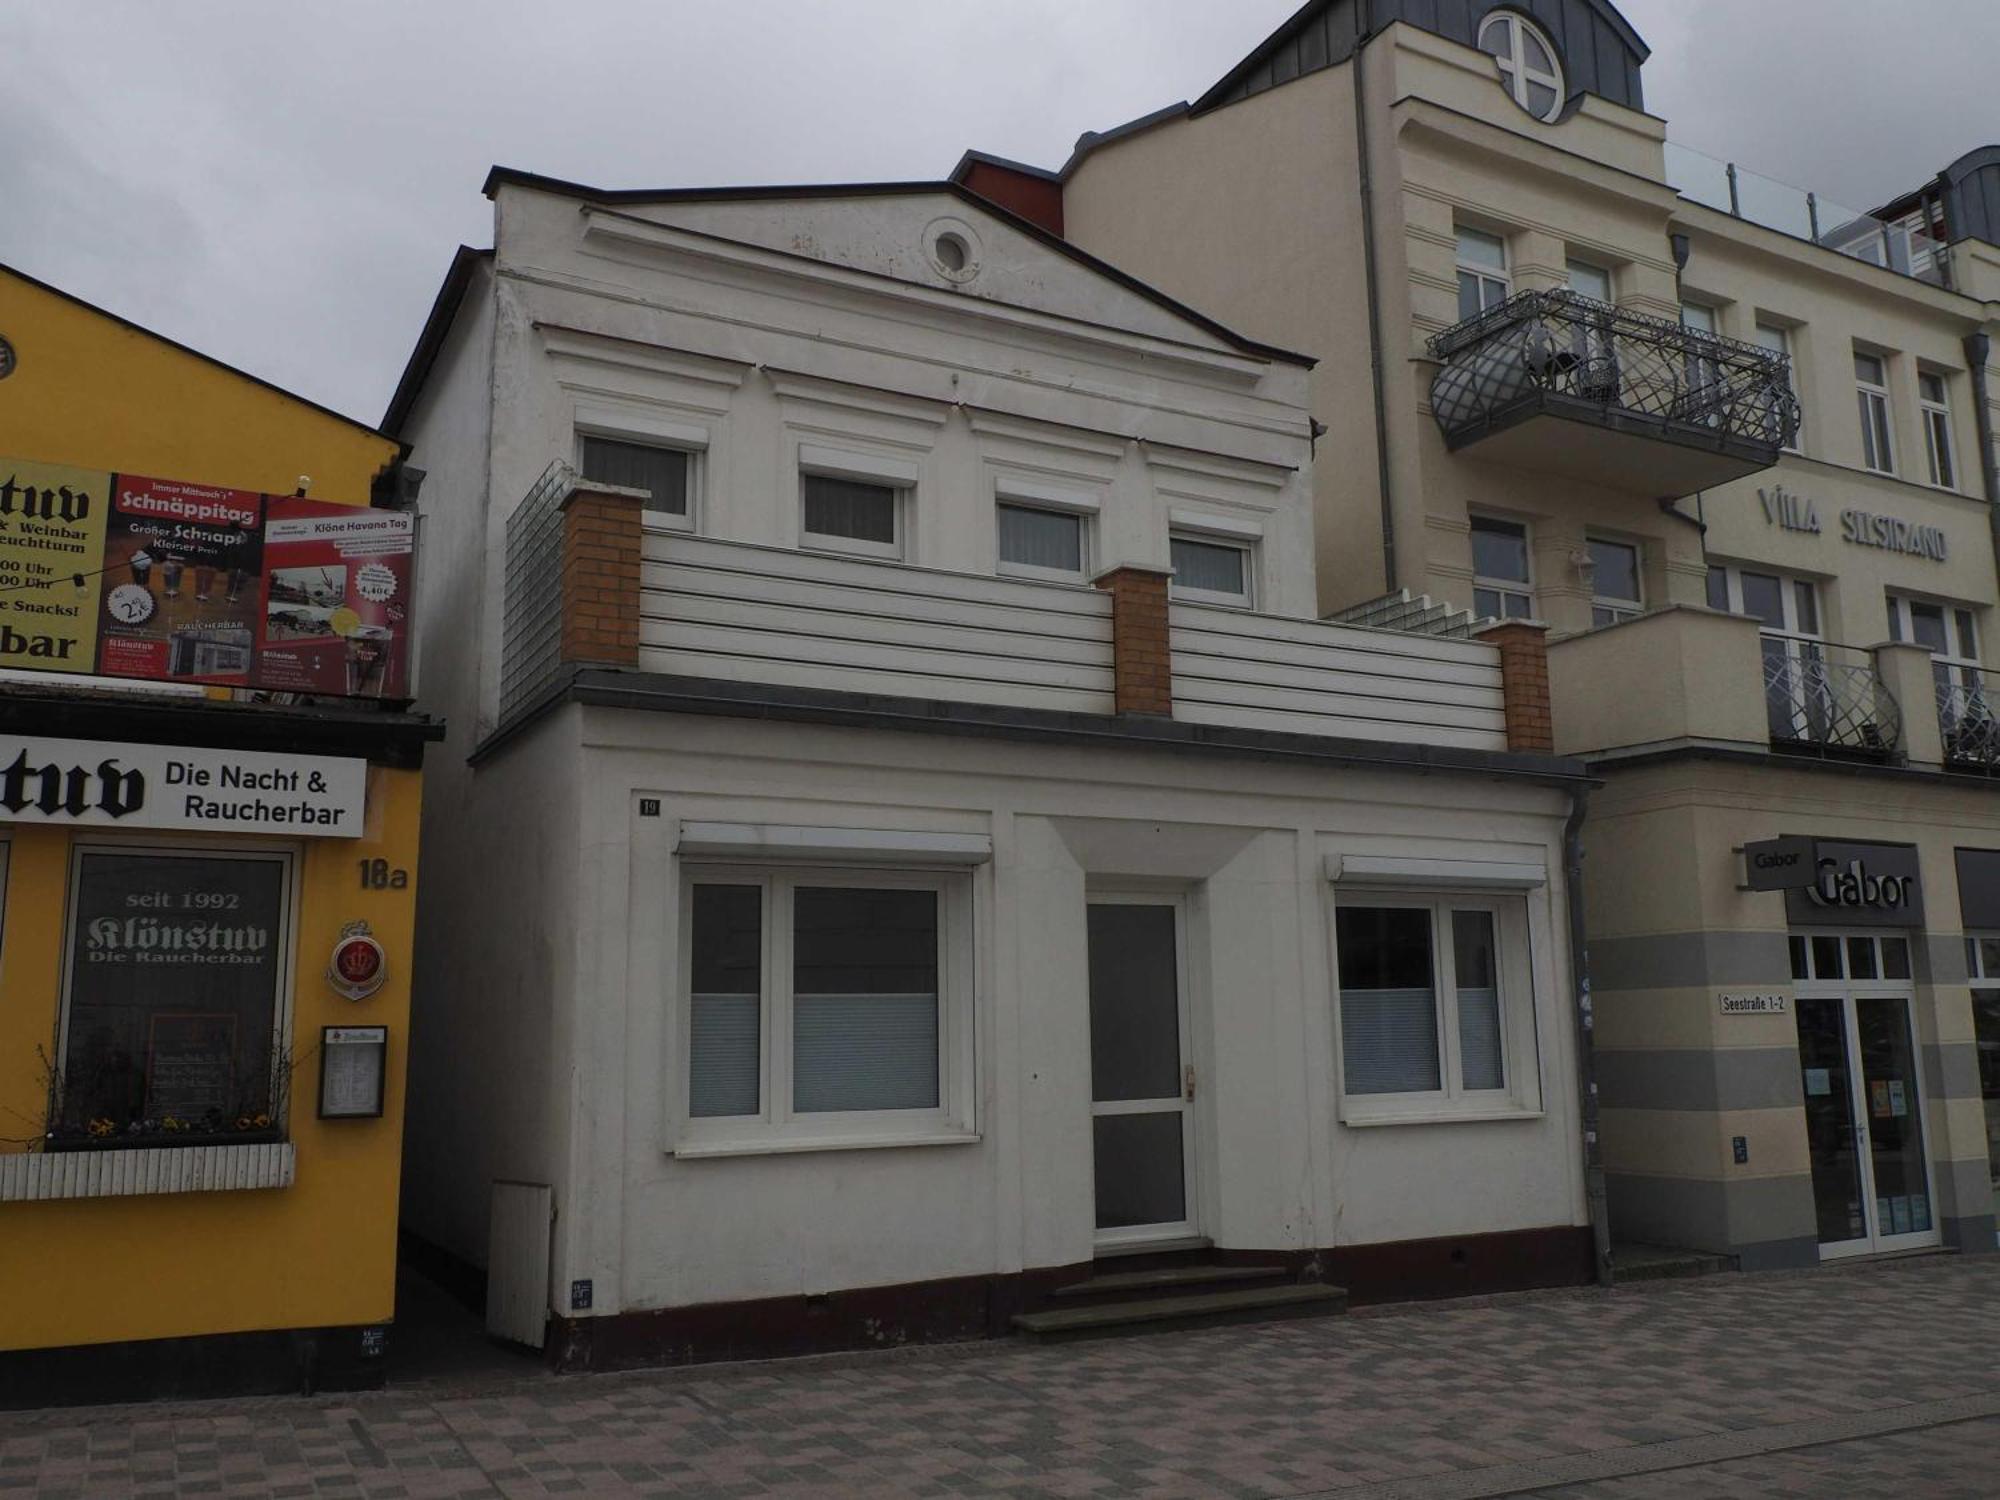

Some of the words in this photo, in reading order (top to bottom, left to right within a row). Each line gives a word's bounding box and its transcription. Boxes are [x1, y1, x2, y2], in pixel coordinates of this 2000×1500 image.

[152, 481, 179, 496] Immer
[122, 491, 254, 525] Schnäppitag
[20, 521, 88, 540] Weinbar
[130, 523, 170, 536] Großer
[315, 523, 345, 533] Klöne
[347, 521, 387, 531] Havana
[389, 519, 408, 530] Tag
[153, 540, 194, 552] Kleiner
[26, 562, 54, 575] Uhr
[25, 576, 51, 589] Uhr
[14, 600, 80, 617] Snacks!
[165, 761, 210, 786] Die
[220, 765, 298, 792] Nacht
[308, 771, 327, 793] &
[184, 795, 346, 825] Raucherbar
[644, 800, 656, 814] 19
[1755, 852, 1800, 868] Gabor
[359, 858, 408, 890] 18a
[1811, 857, 1913, 909] Gabor
[126, 892, 172, 908] seit
[180, 893, 240, 909] 1992
[90, 951, 127, 963] Die
[136, 951, 264, 964] Raucherbar
[1723, 995, 1766, 1011] Seestraße
[1769, 995, 1784, 1010] 1-2
